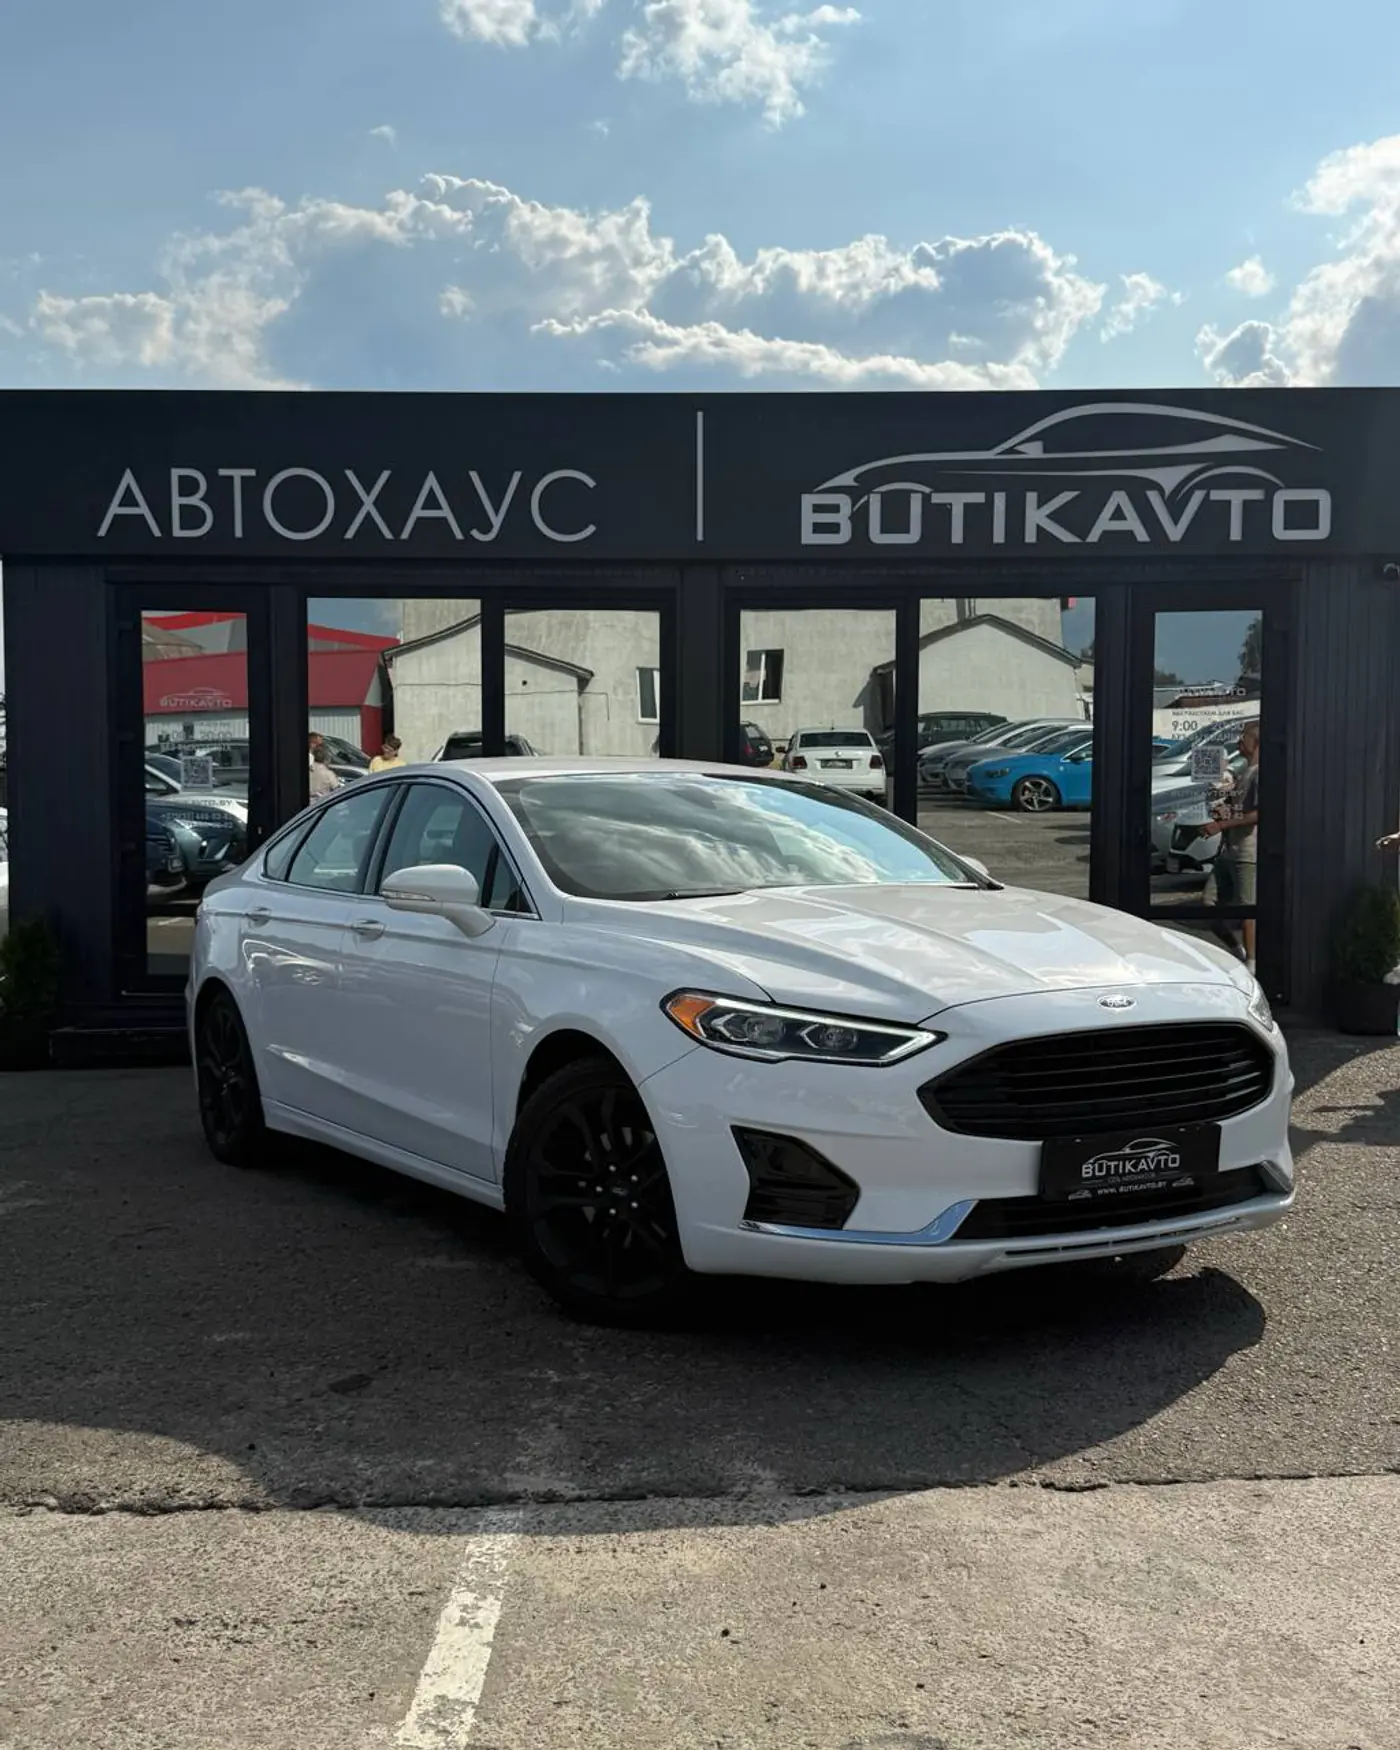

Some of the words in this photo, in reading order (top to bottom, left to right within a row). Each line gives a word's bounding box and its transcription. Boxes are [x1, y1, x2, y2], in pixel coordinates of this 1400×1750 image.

[97, 467, 597, 543] АВТОХАУС
[801, 488, 1332, 545] BUTIKAVTO
[1171, 720, 1198, 731] 9:00
[1081, 1153, 1180, 1178] BUTIKAVTO
